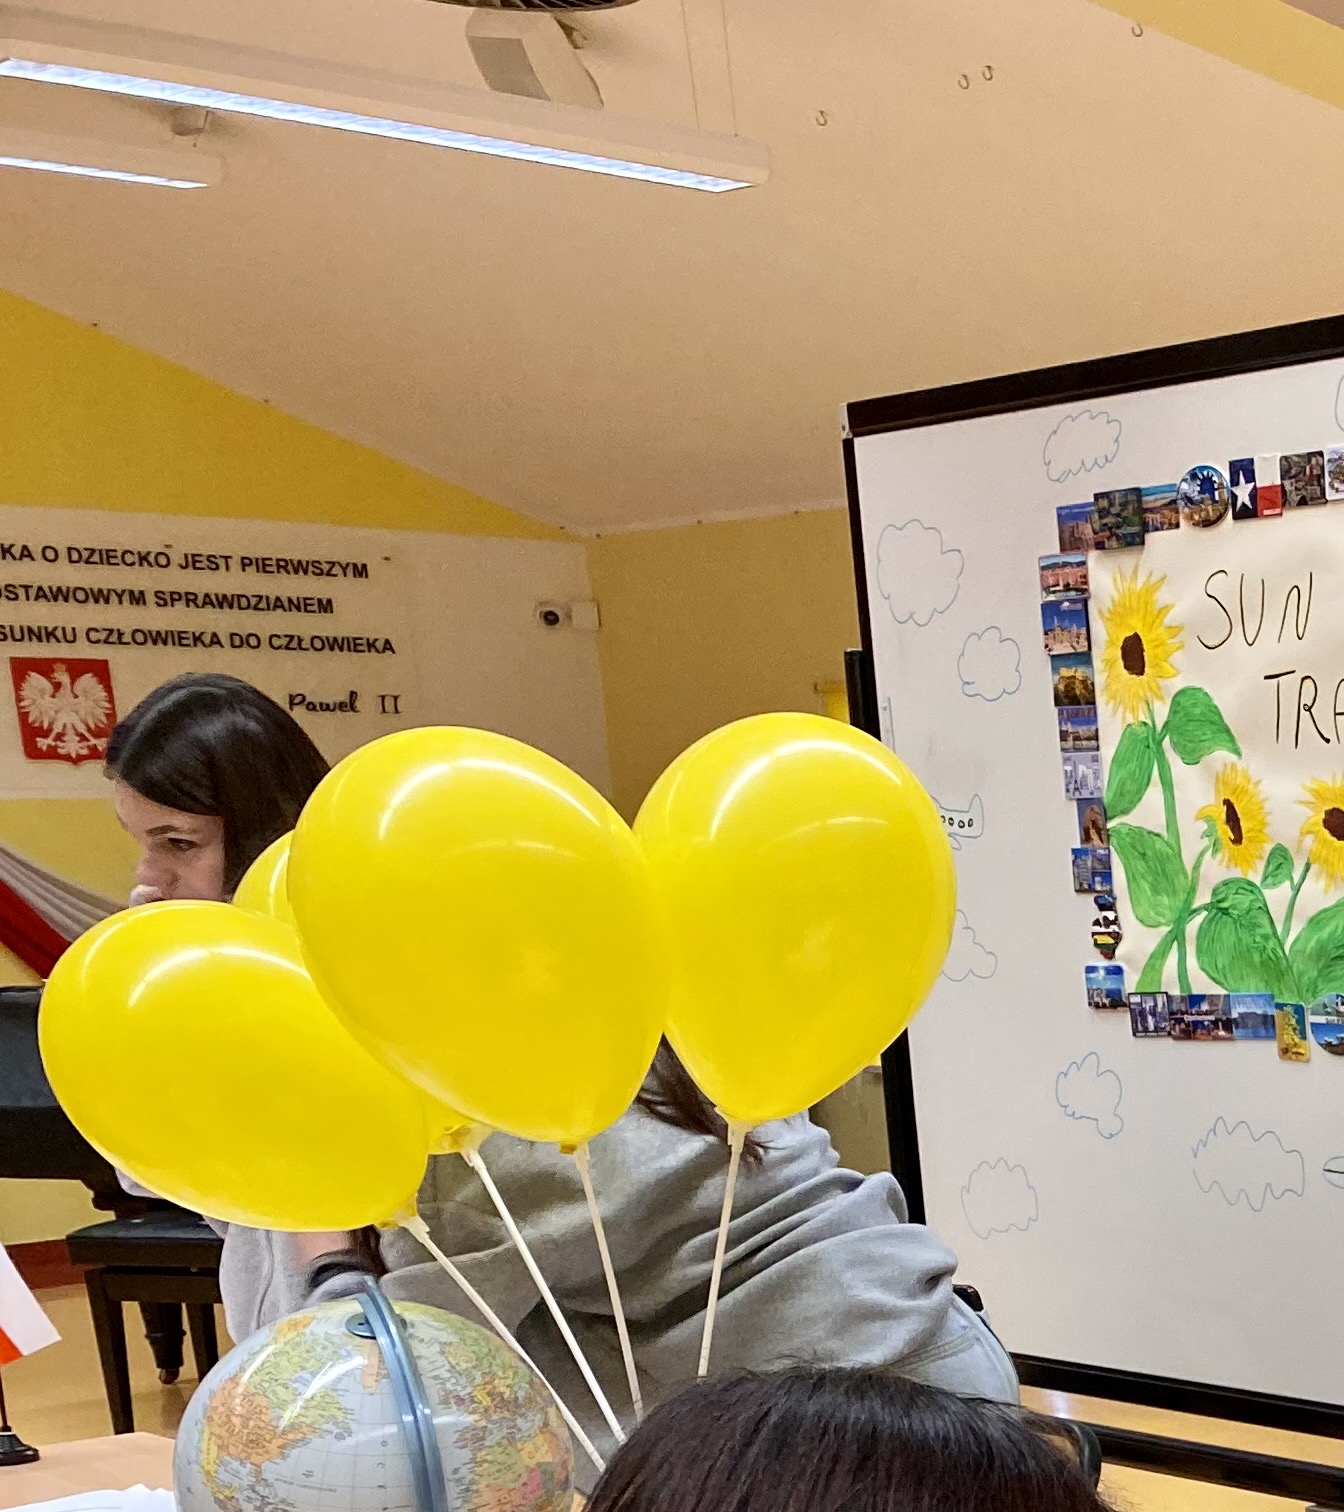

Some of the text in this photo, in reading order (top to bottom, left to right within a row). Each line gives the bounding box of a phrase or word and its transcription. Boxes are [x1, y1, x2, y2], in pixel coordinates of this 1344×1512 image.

[0, 543, 369, 579] KA O DZIECKO JEST PIERWSZYM
[0, 584, 334, 614] STAWOWYM SPRAWDZIANEM
[1196, 569, 1313, 650] SUN
[0, 624, 396, 655] SUNKU CZŁOWIEKA DO CZŁOWIEKA
[378, 694, 401, 714] II
